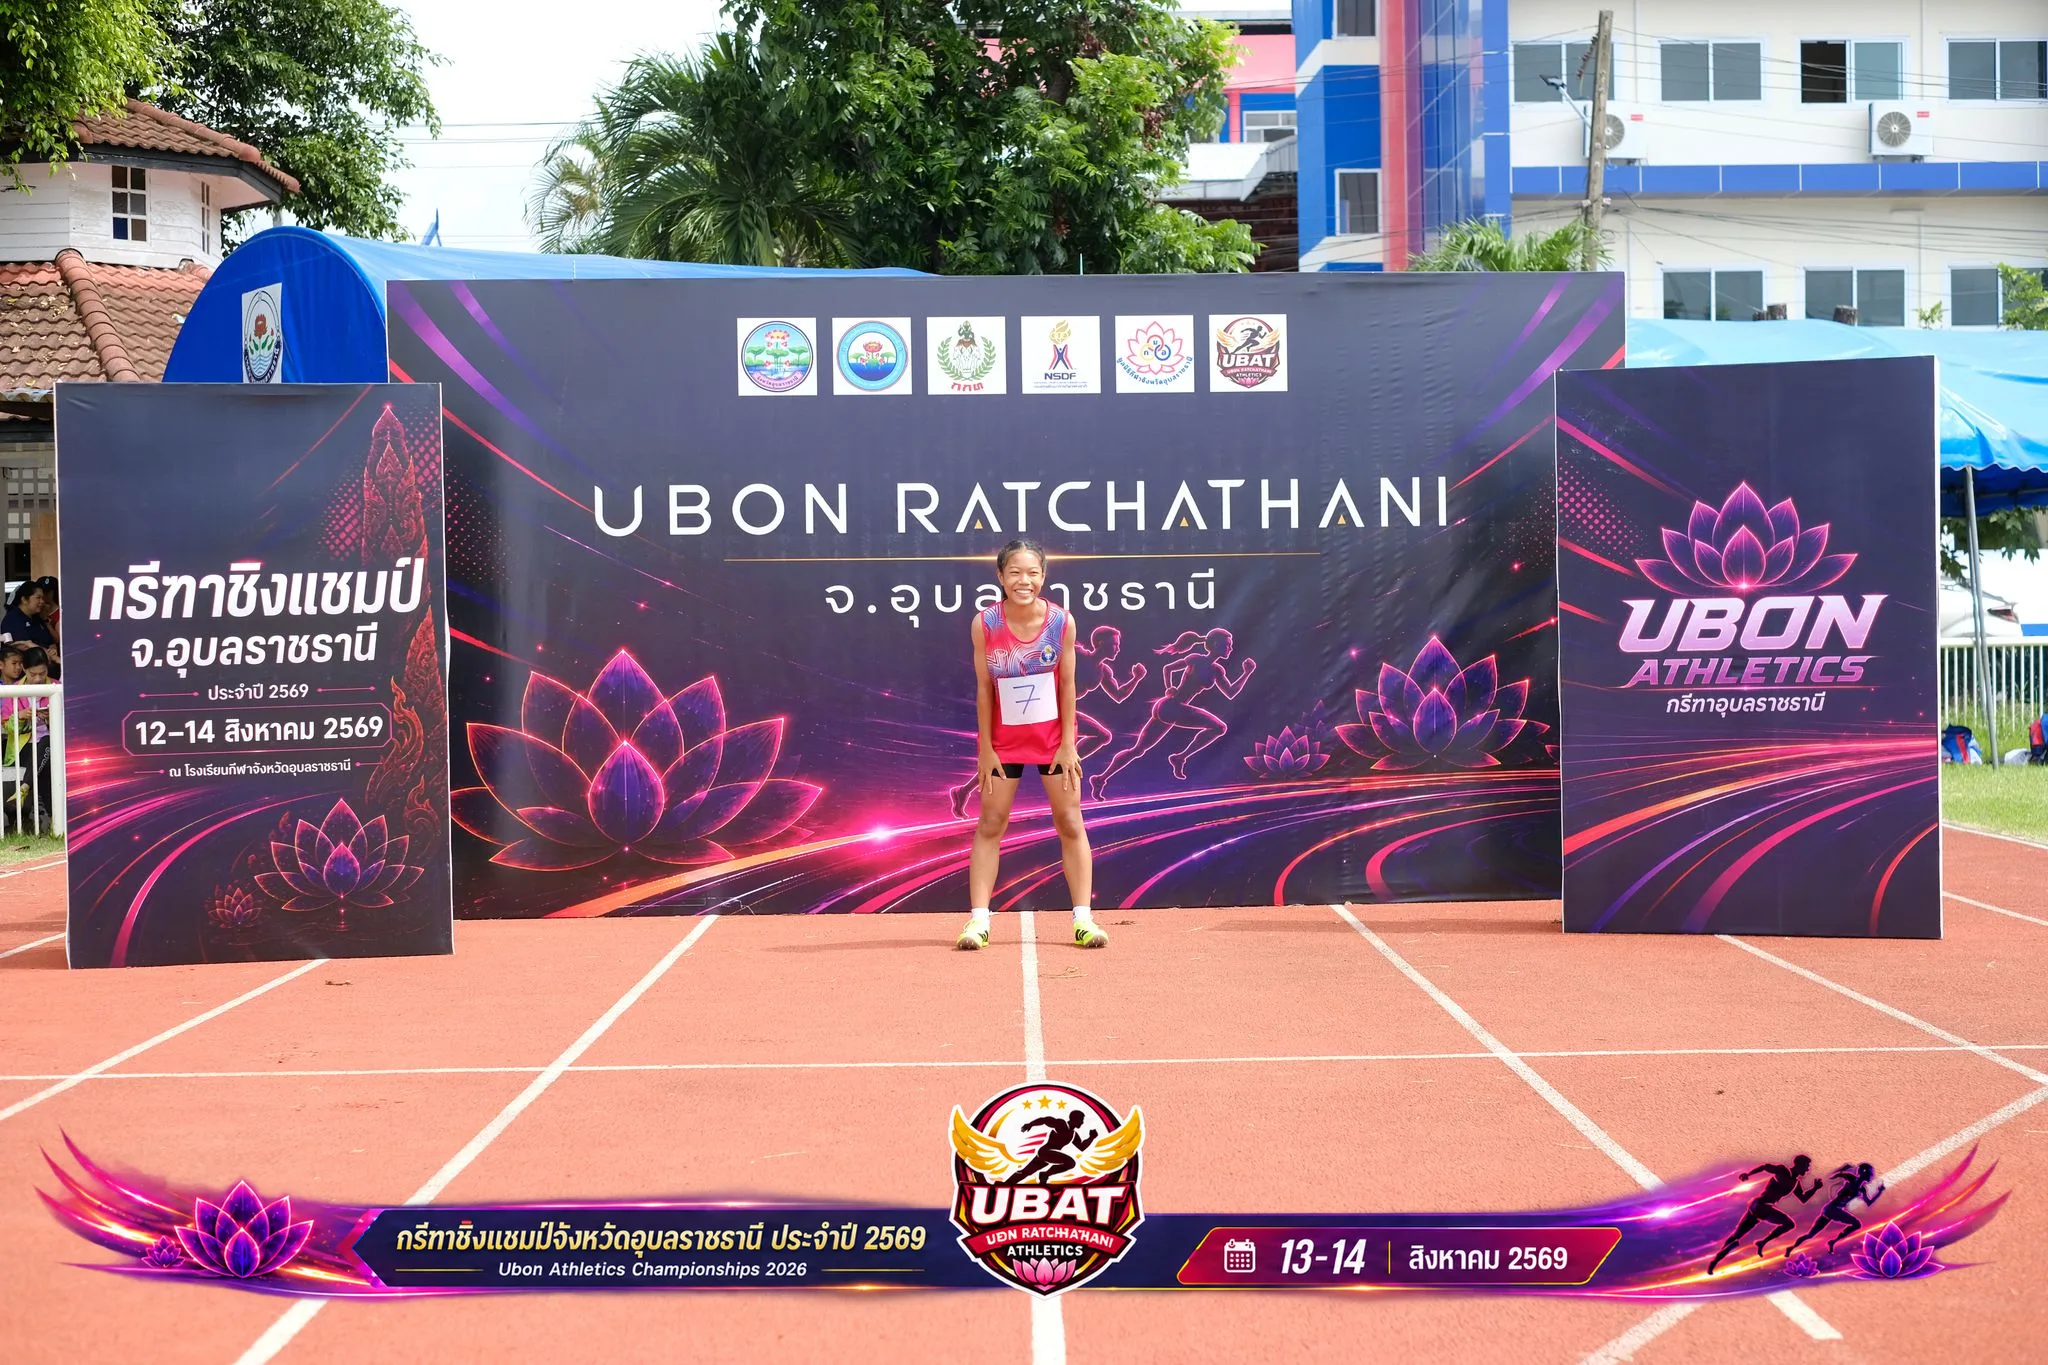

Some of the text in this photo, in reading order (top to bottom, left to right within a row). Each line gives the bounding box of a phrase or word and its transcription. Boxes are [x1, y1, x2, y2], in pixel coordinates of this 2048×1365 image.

[1222, 354, 1276, 368] UBAT
[1044, 372, 1077, 381] NSDF
[594, 475, 1447, 537] UBON RATCHATHANI
[824, 567, 1215, 628] จ.อุบลาชธานี
[1618, 594, 1890, 653] UBON
[130, 622, 379, 679] จ.อุบลราชธานี
[1620, 655, 1876, 688] ATHLETICS
[208, 682, 309, 701] ประจำปี 2569
[1012, 684, 1041, 714] 7
[224, 718, 315, 742] สิงหาคม
[323, 715, 384, 739] 2569
[169, 768, 182, 778] ณ
